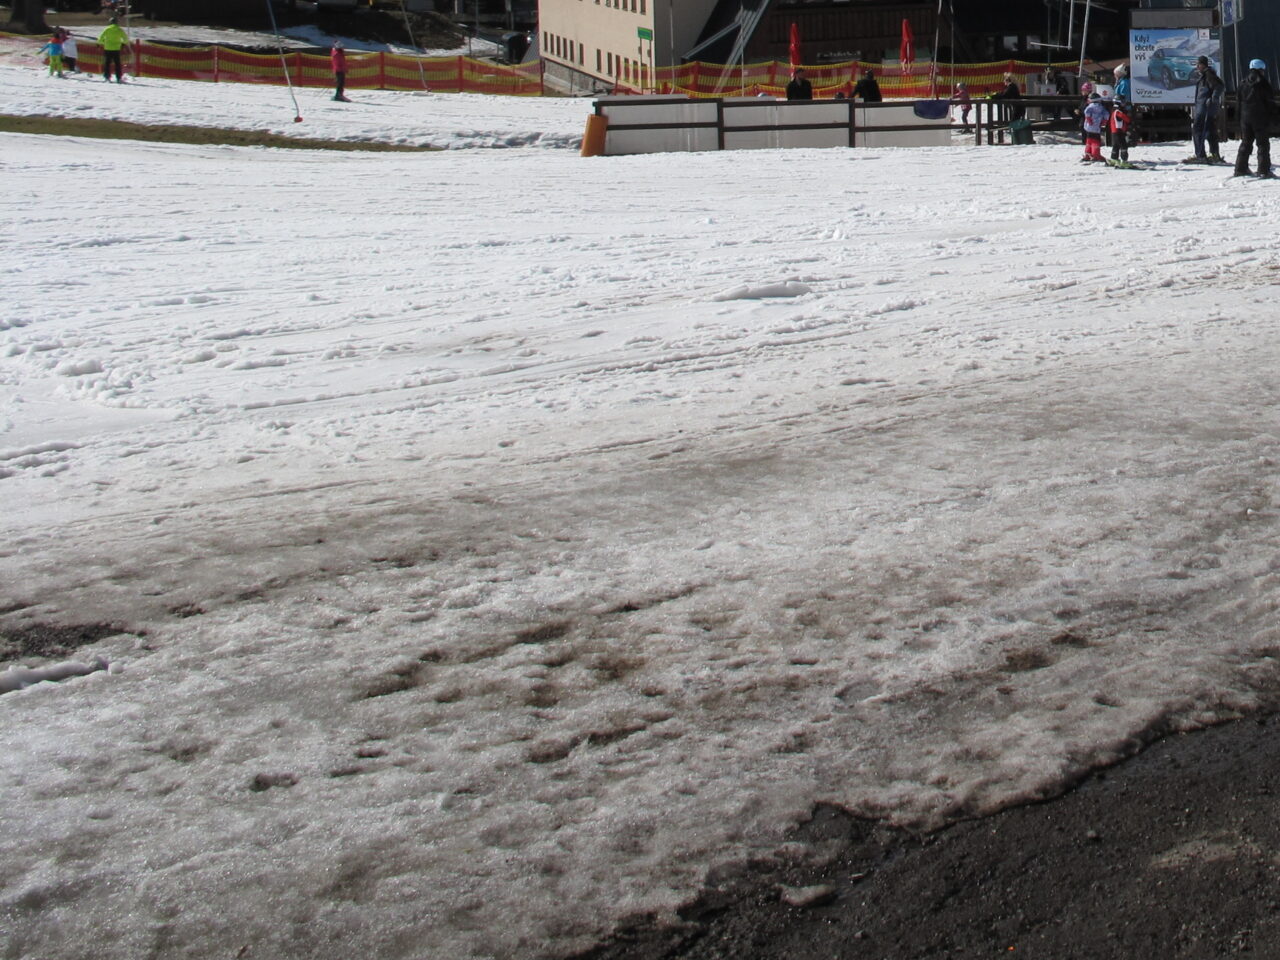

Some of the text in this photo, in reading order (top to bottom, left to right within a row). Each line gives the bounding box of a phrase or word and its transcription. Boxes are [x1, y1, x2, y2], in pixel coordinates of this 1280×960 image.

[1134, 34, 1150, 44] Když
[1134, 43, 1155, 52] chcete
[1134, 52, 1147, 62] výš
